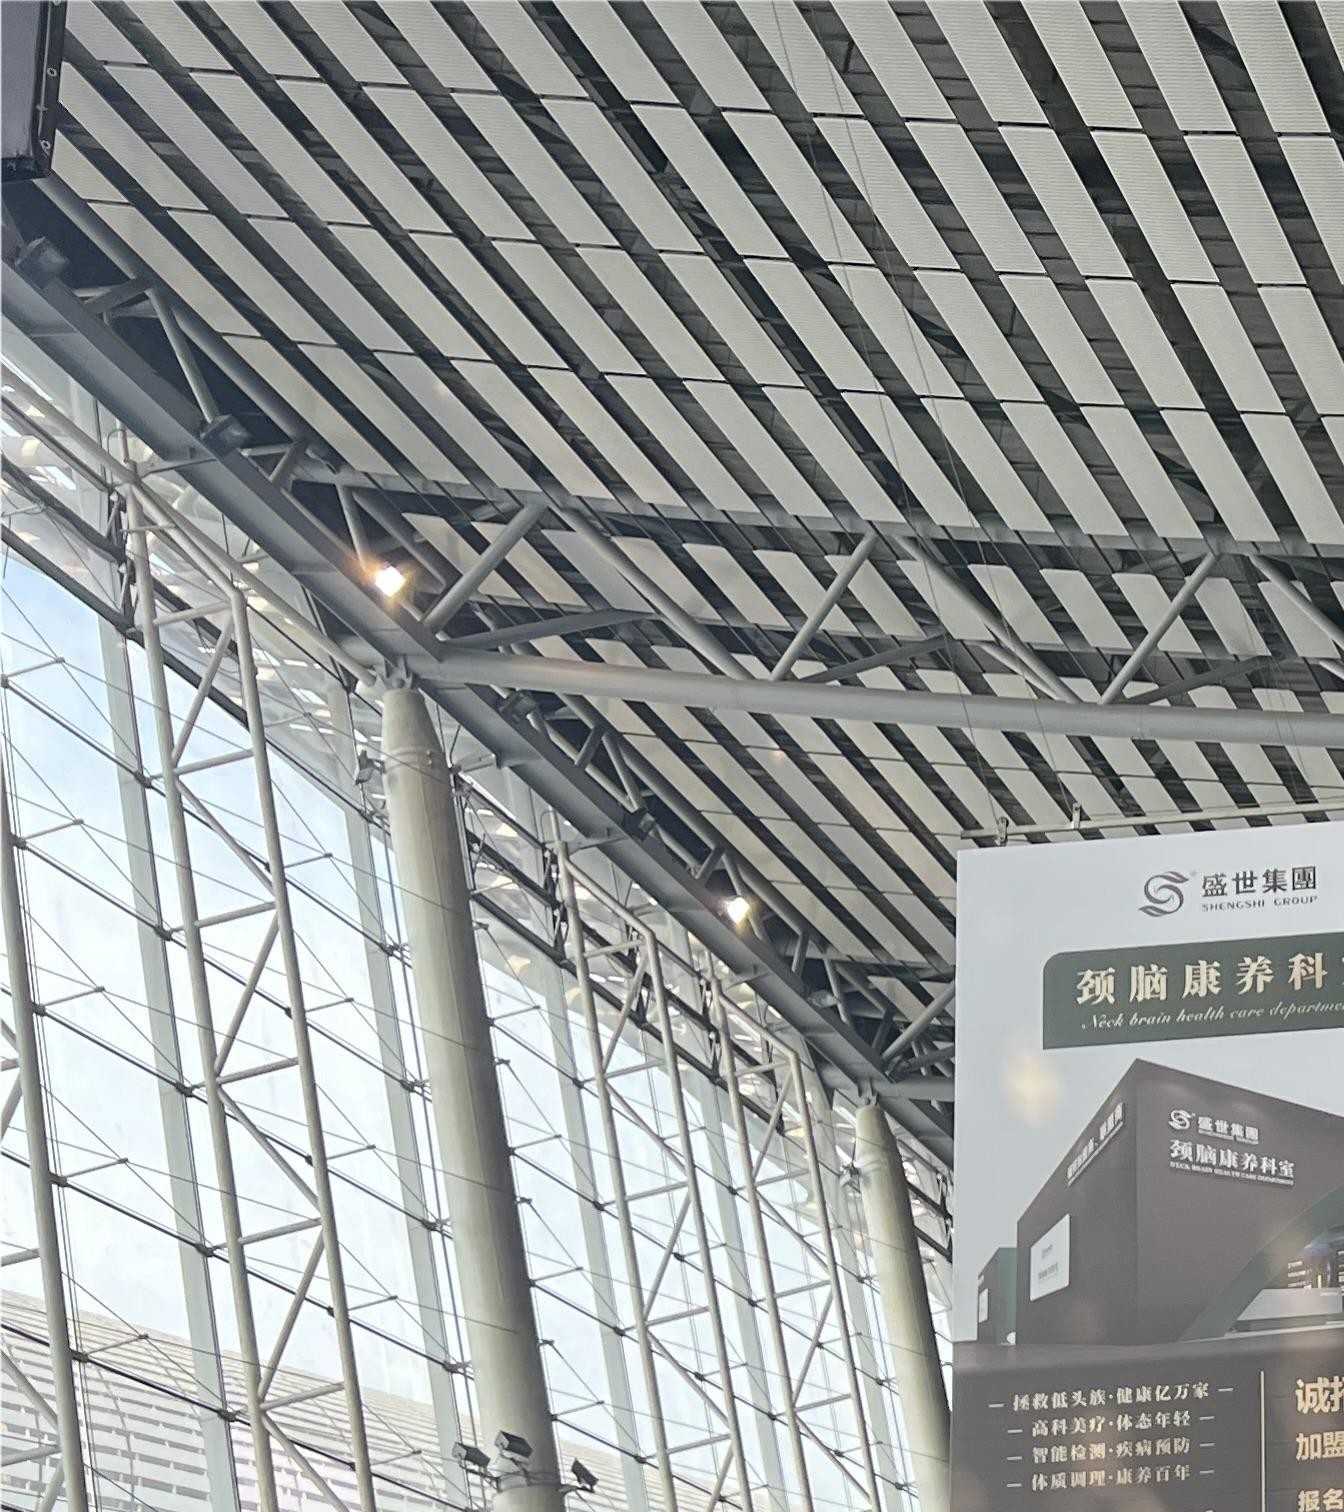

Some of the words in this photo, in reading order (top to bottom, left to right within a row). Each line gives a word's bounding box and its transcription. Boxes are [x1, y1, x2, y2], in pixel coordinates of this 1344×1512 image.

[1202, 899, 1265, 912] SHENGSHI
[1274, 894, 1318, 907] GROUP
[1129, 1010, 1171, 1028] brain
[1176, 1005, 1225, 1023] health
[1230, 1006, 1264, 1019] care
[1170, 1139, 1294, 1178] 颈脑康养科室
